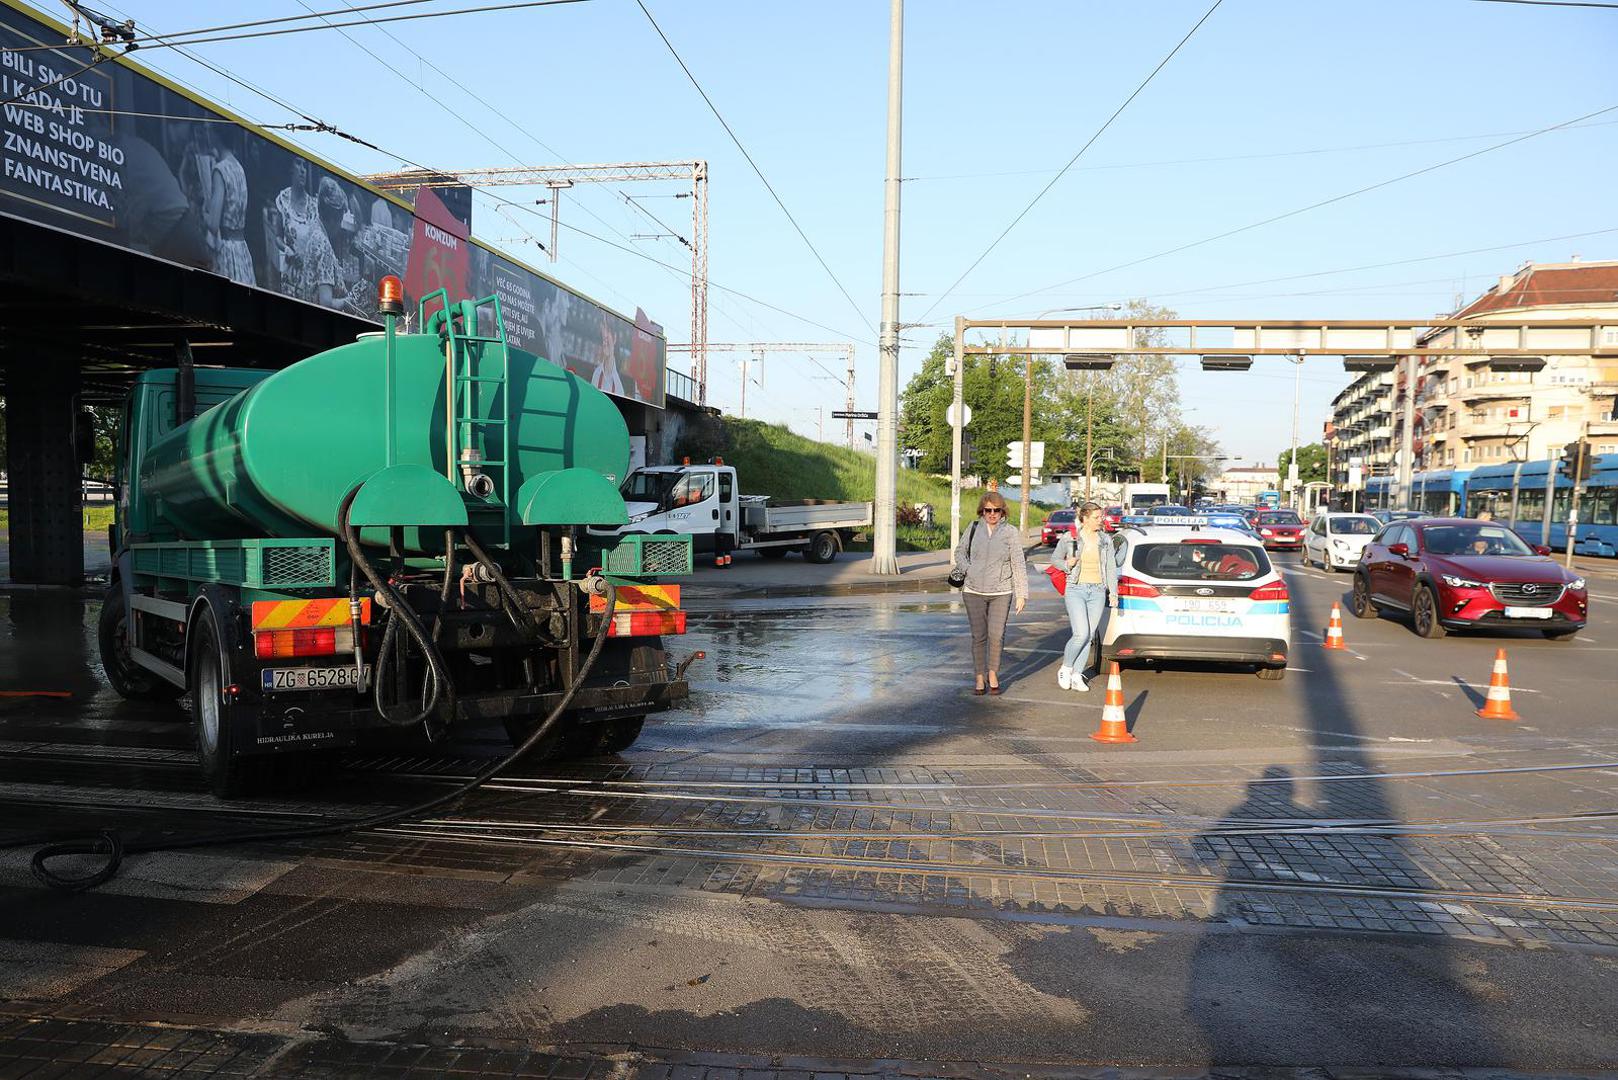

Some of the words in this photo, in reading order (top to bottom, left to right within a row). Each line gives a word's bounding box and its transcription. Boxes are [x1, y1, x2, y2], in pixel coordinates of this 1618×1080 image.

[2, 75, 8, 94] I
[14, 79, 65, 118] KADA
[69, 104, 85, 126] JE
[3, 47, 33, 77] BILI
[38, 65, 77, 96] SMO
[79, 83, 102, 107] TU
[3, 103, 45, 135] WEB
[49, 121, 95, 153] SHOP
[98, 141, 125, 166] BIO
[4, 129, 123, 190] ZNANSTVENA
[4, 157, 115, 212] FANTASTIKA.
[424, 222, 457, 250] KONZUM
[1166, 614, 1243, 627] POLICIJA
[276, 671, 296, 688] ZG
[257, 735, 301, 745] HIDRAULIKA
[302, 731, 334, 741] KURELJA
